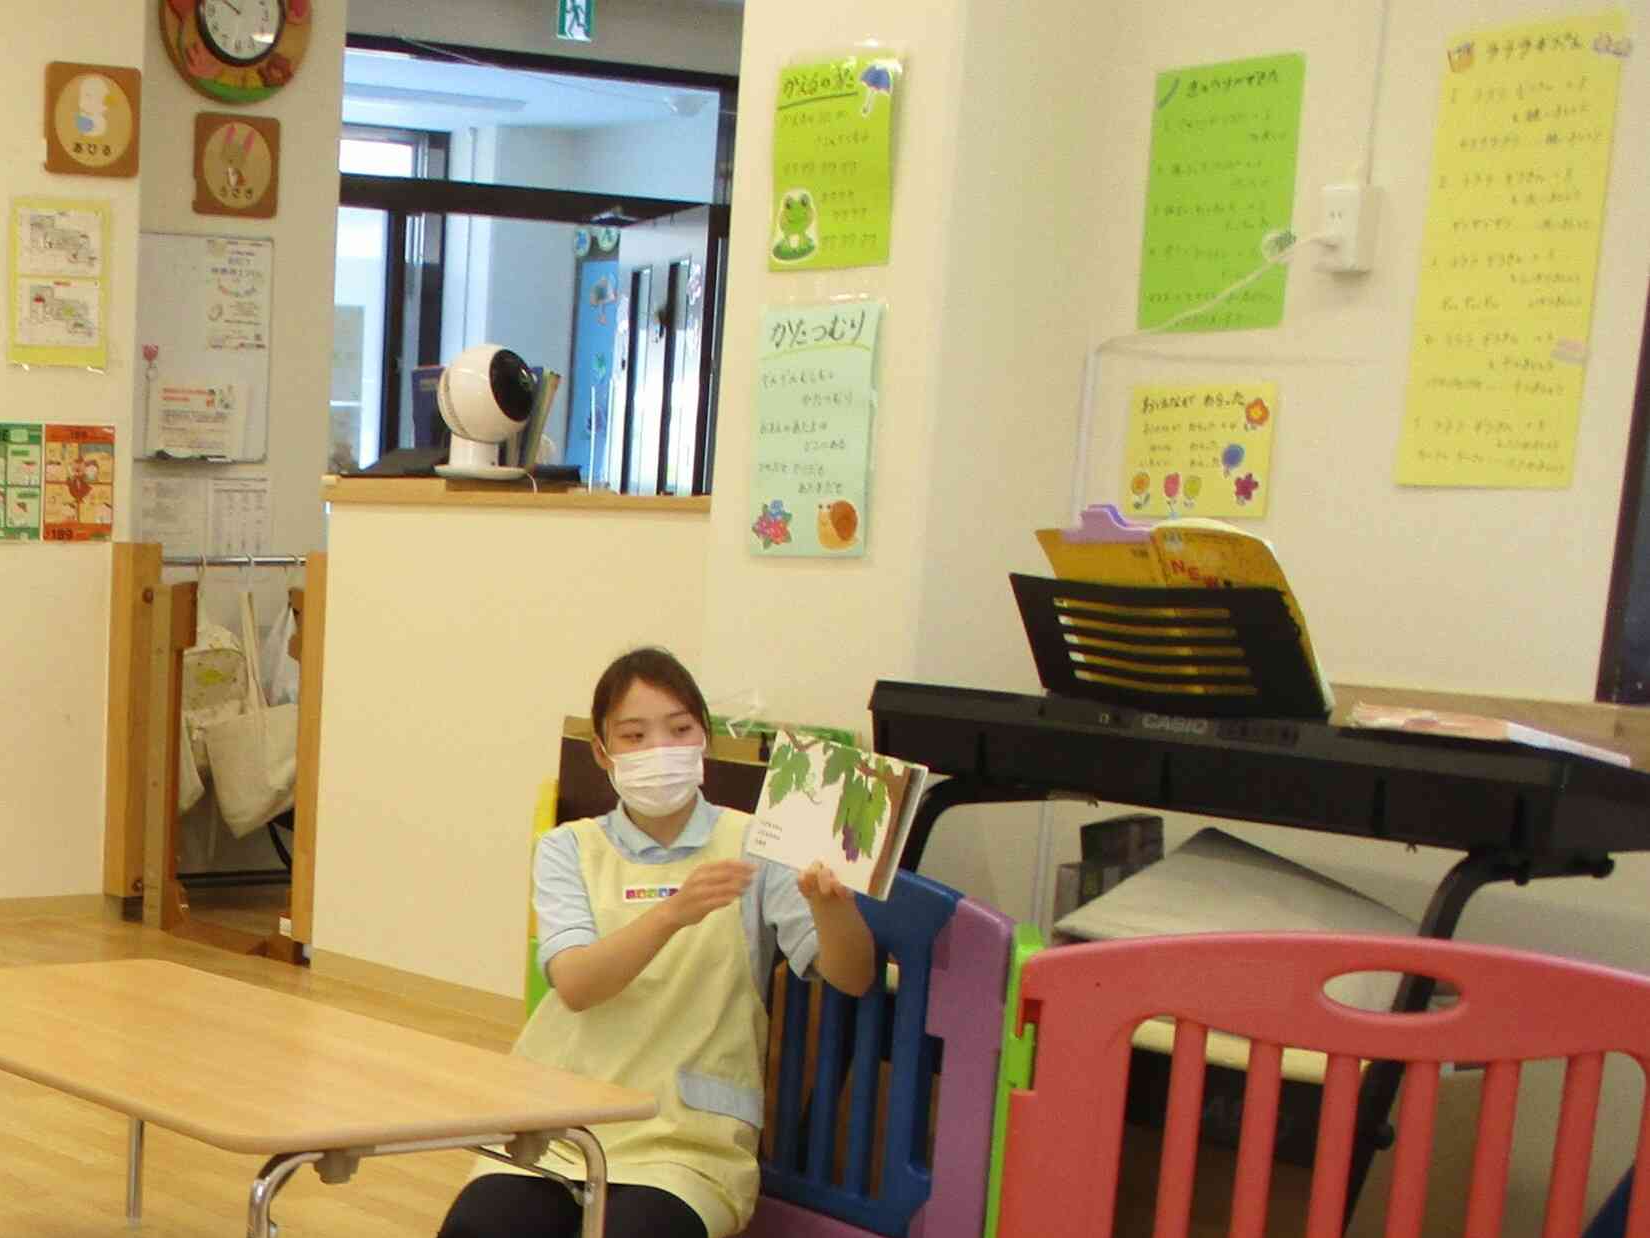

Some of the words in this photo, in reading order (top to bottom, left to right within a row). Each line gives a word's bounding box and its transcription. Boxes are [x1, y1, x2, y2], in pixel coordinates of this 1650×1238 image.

[771, 309, 866, 349] かたつむり
[1141, 712, 1209, 735] CASIO
